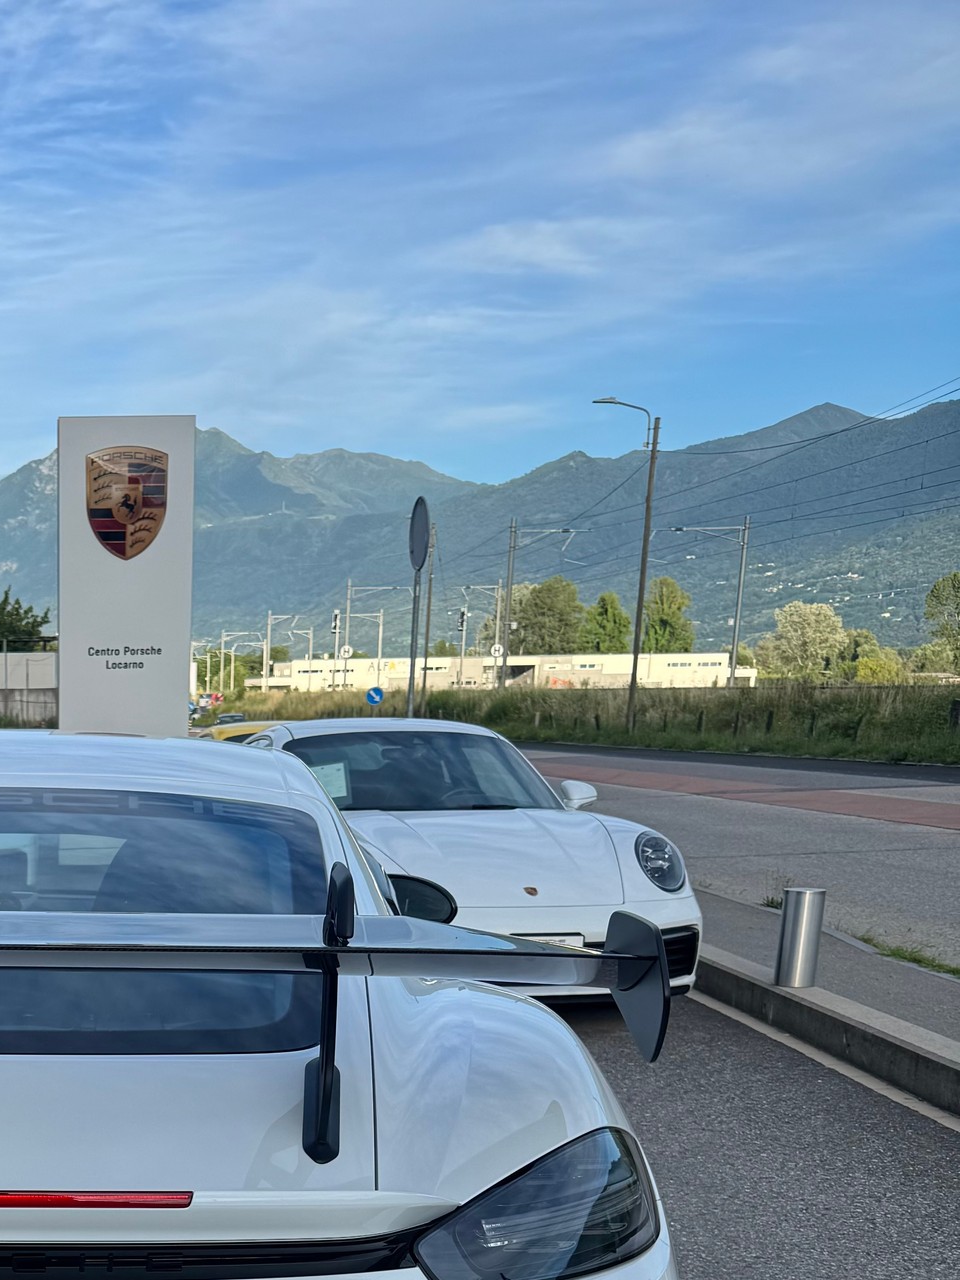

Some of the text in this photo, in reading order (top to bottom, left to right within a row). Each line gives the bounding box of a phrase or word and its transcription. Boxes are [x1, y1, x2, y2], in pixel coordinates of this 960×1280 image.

[90, 451, 164, 467] PORSCHE
[87, 645, 162, 657] Centro Porsche
[105, 660, 144, 670] Locarno
